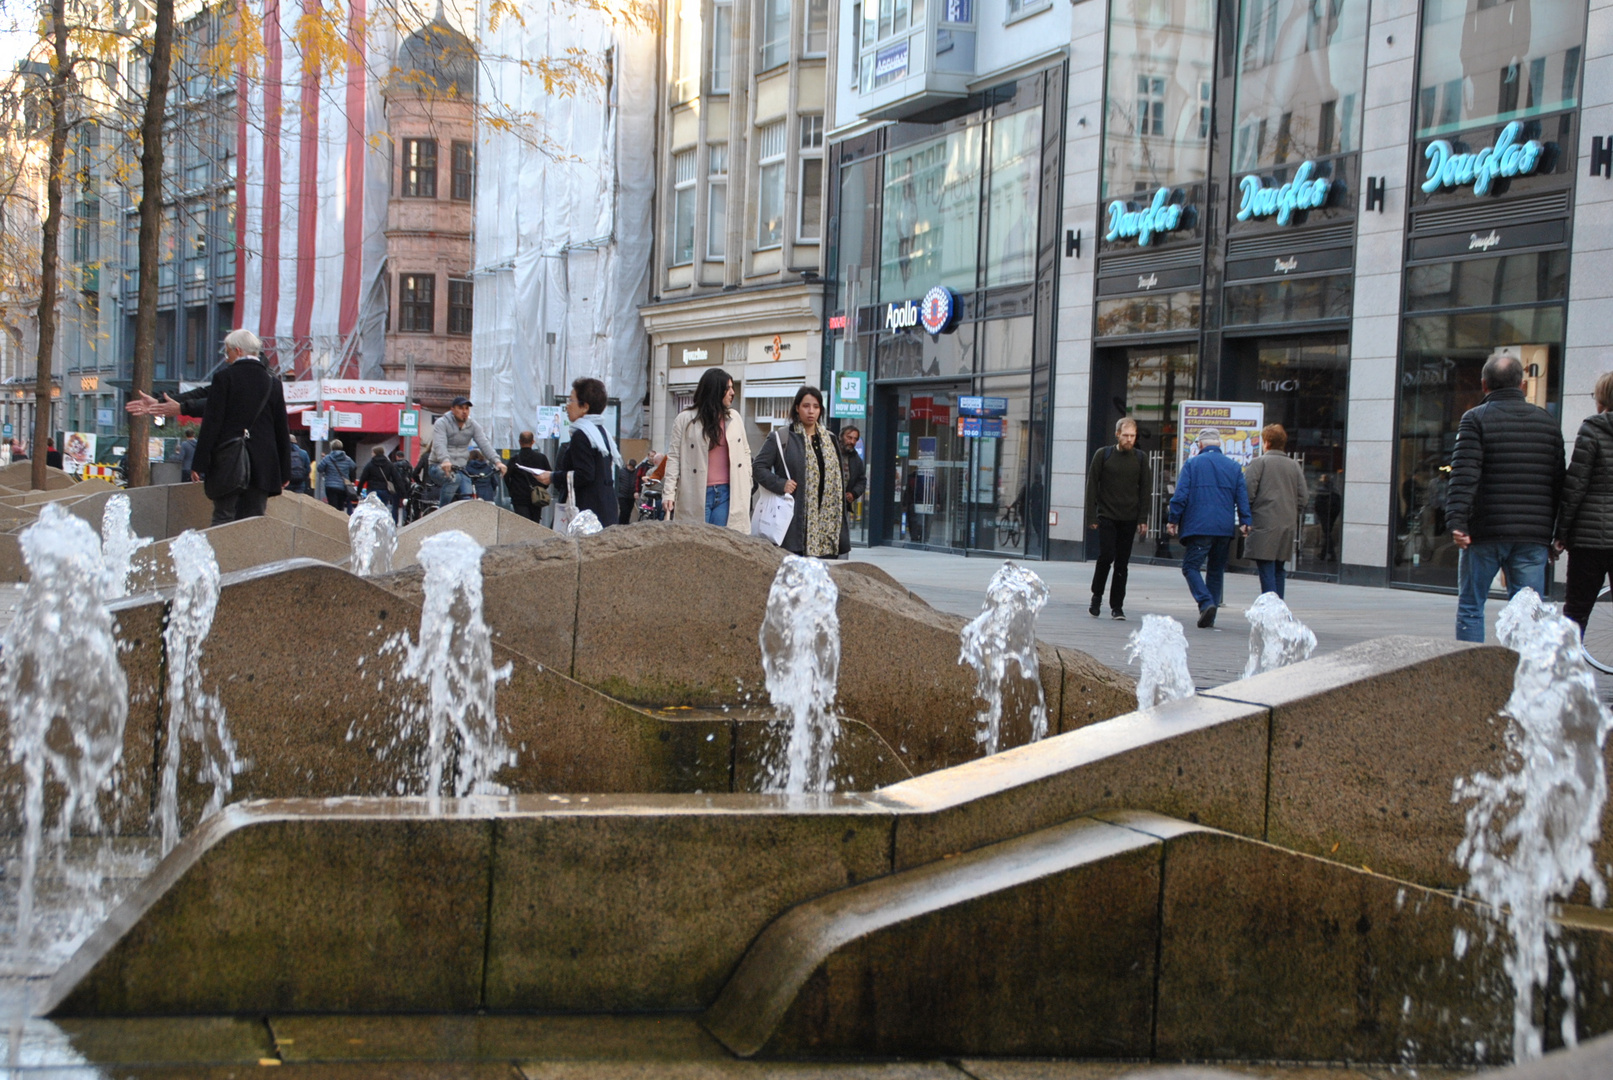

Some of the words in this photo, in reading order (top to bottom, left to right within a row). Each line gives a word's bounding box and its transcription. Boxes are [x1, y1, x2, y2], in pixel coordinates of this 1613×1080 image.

[1421, 121, 1544, 198] Douglas
[1236, 160, 1332, 226] Douglas
[1105, 187, 1182, 247] Douglas
[1469, 229, 1501, 251] Douglas
[1274, 256, 1298, 274] Douglas
[885, 300, 918, 334] Apollo
[322, 385, 356, 395] Eiscafé
[359, 386, 366, 395] &
[369, 386, 406, 396] Pizzeria
[844, 382, 857, 391] JR
[835, 403, 849, 412] NOW
[850, 403, 865, 412] OPEN
[1187, 408, 1198, 416] 25
[1200, 408, 1229, 417] JAHRE
